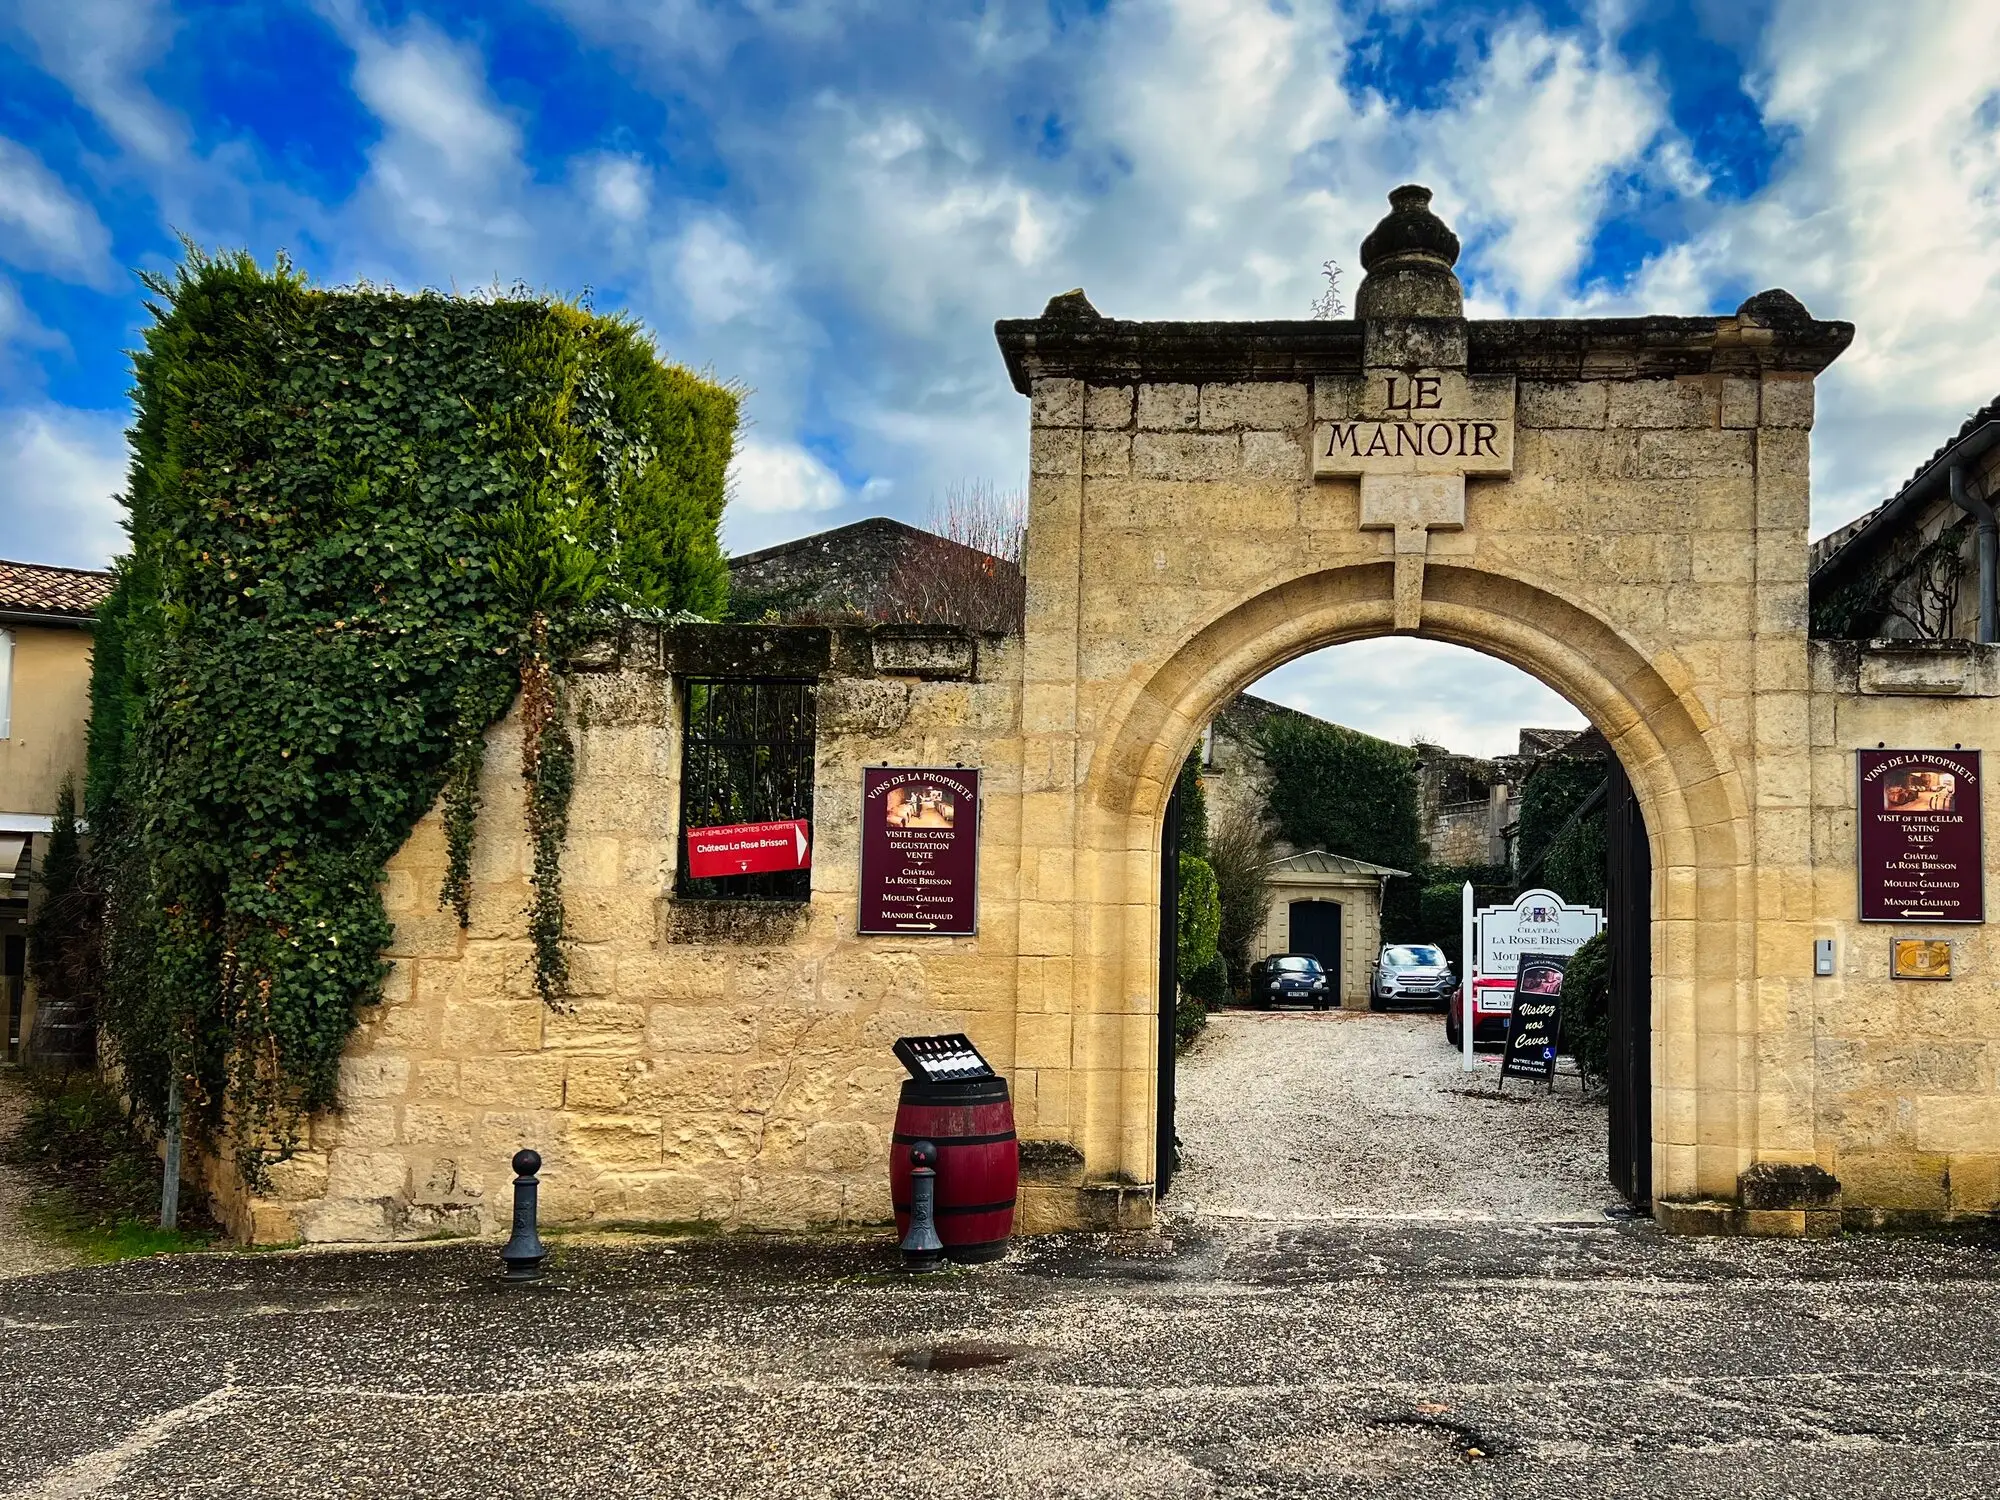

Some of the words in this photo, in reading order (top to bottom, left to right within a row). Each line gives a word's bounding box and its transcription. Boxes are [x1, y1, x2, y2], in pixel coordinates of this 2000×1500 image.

[1384, 377, 1443, 411] LE
[1325, 423, 1500, 458] MANOIR
[1864, 763, 1888, 782] VINS
[1888, 757, 1903, 767] DE
[1905, 755, 1919, 763] LA
[1922, 754, 1977, 784] PROPRIETE
[868, 781, 891, 800] VINS
[891, 774, 905, 785] DE
[907, 773, 920, 781] LA
[923, 773, 974, 802] PROPRIETE
[1877, 814, 1900, 822] VISIT
[1930, 815, 1963, 823] CELLAR
[734, 826, 760, 835] PORTES
[761, 823, 795, 832] OUVERTES
[886, 830, 912, 838] VISITE
[929, 831, 955, 839] CAVES
[730, 842, 740, 850] La
[741, 841, 759, 849] Rose
[760, 839, 788, 847] Brisson
[890, 842, 949, 850] DEGUSTATION
[1519, 1003, 1556, 1017] Visitez
[1525, 1020, 1545, 1030] nos
[1514, 1033, 1550, 1049] Caves
